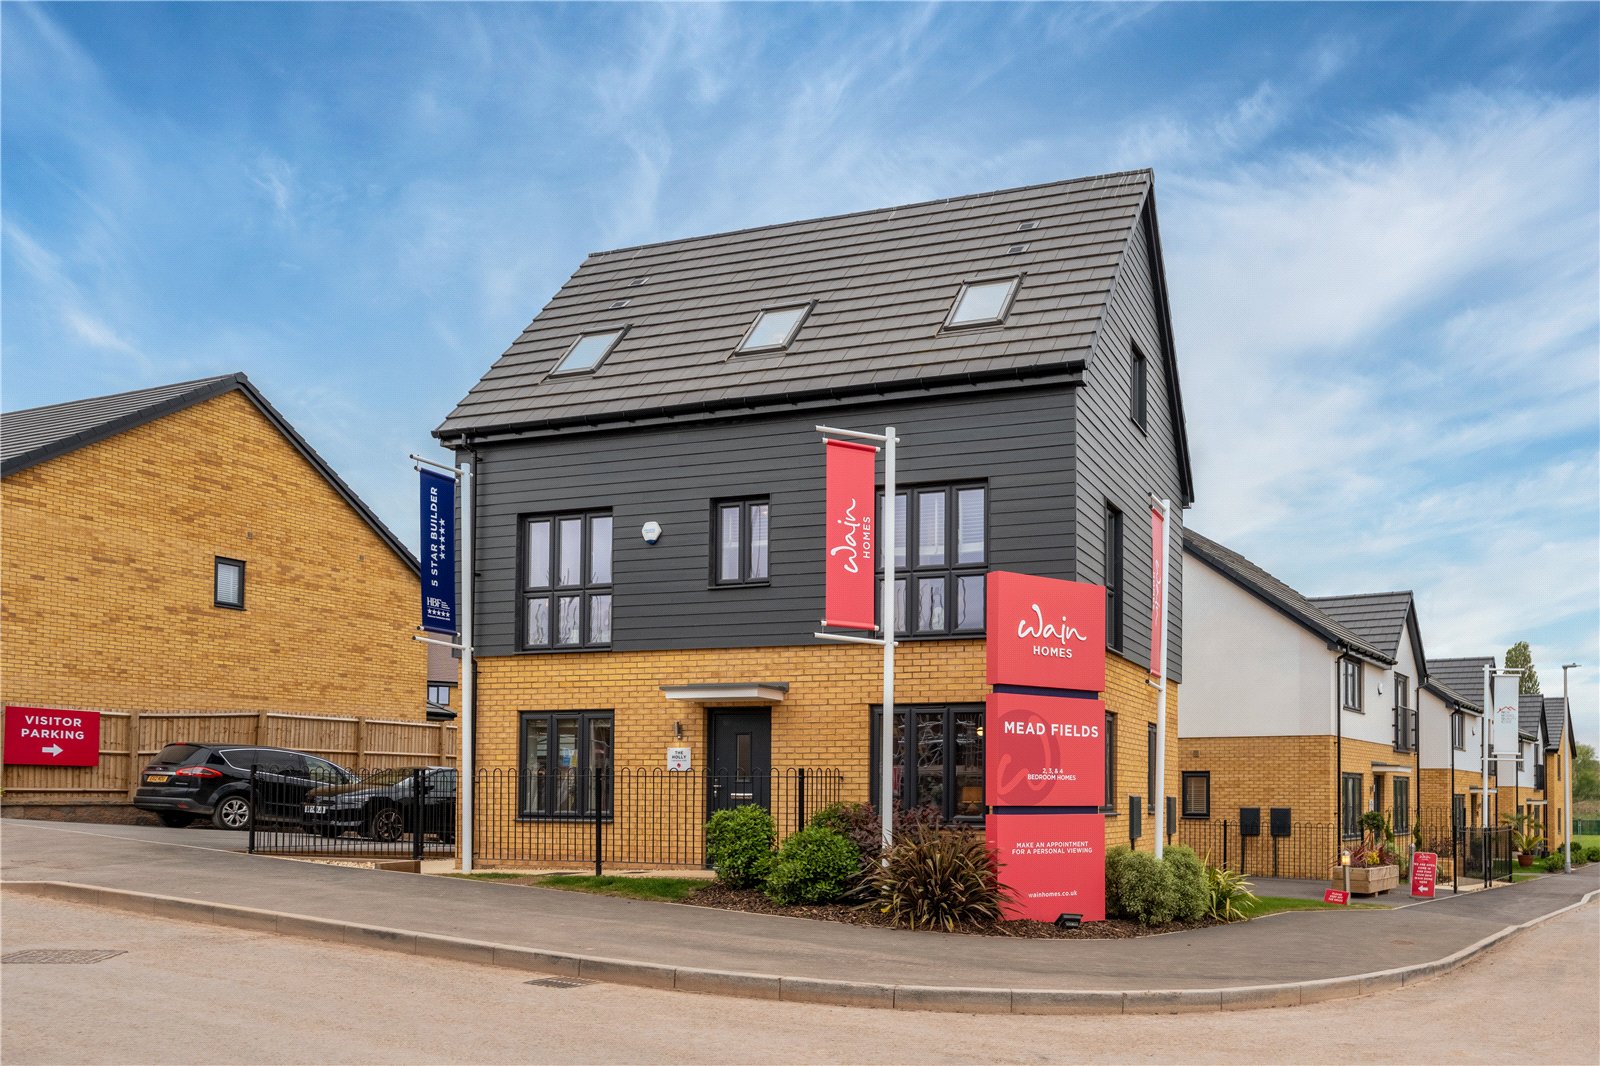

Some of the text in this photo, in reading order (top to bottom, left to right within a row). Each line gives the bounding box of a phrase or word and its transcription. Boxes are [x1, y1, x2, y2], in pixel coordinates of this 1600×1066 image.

[430, 486, 439, 587] 5 STAR BUILDER
[862, 516, 871, 559] HOMES
[1033, 645, 1073, 659] HOMES
[25, 715, 82, 727] VISITOR
[21, 728, 85, 740] PARKING
[1004, 721, 1099, 738] MEAD FIELDS
[1027, 773, 1056, 781] BEDROOM
